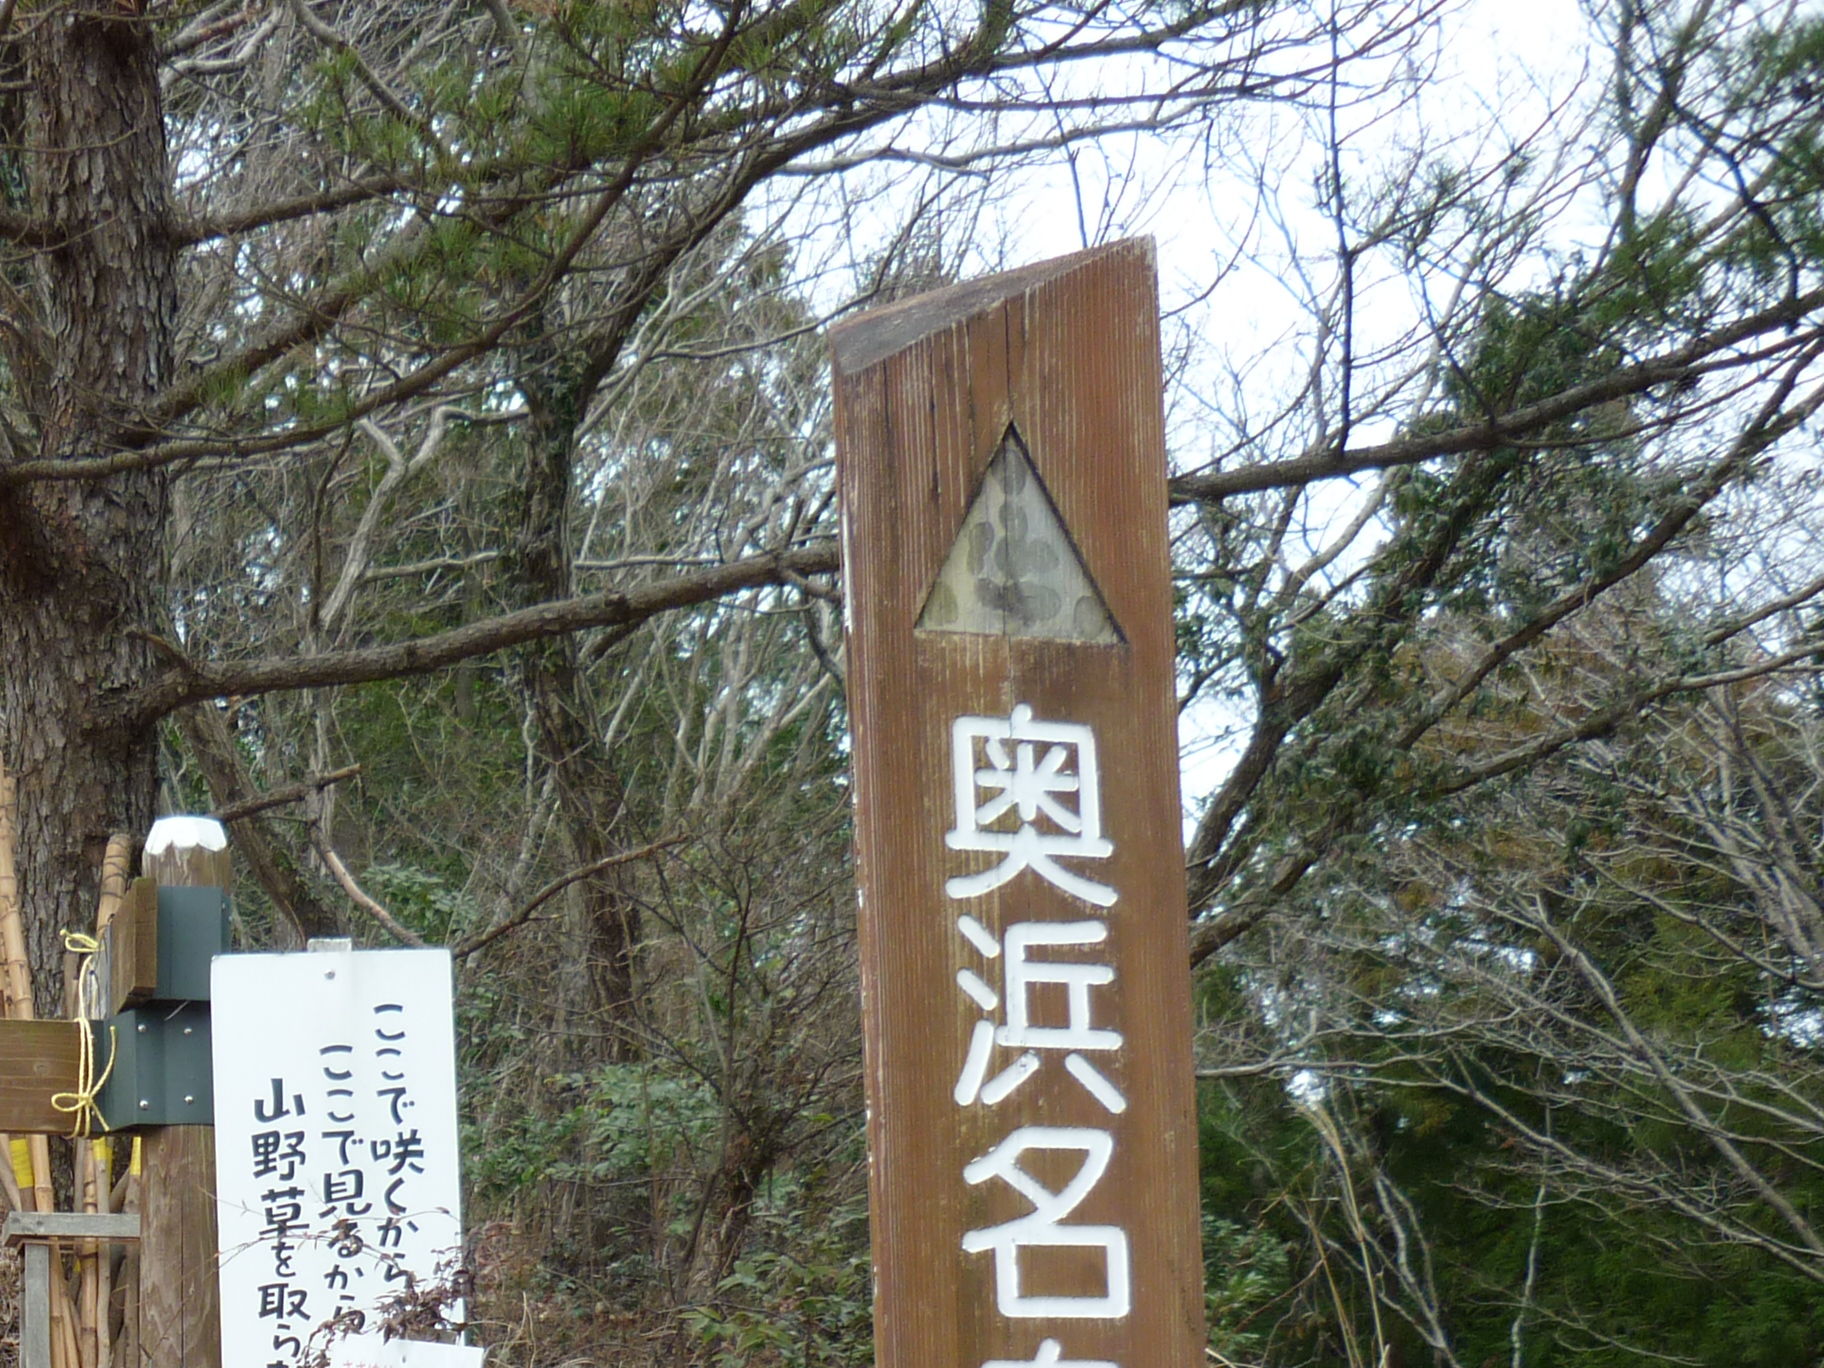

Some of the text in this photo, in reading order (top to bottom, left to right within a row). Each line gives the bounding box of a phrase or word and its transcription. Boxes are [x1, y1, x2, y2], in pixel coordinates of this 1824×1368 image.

[318, 1044, 373, 1331] ここで見るから
[370, 1003, 425, 1284] ここで咲くから
